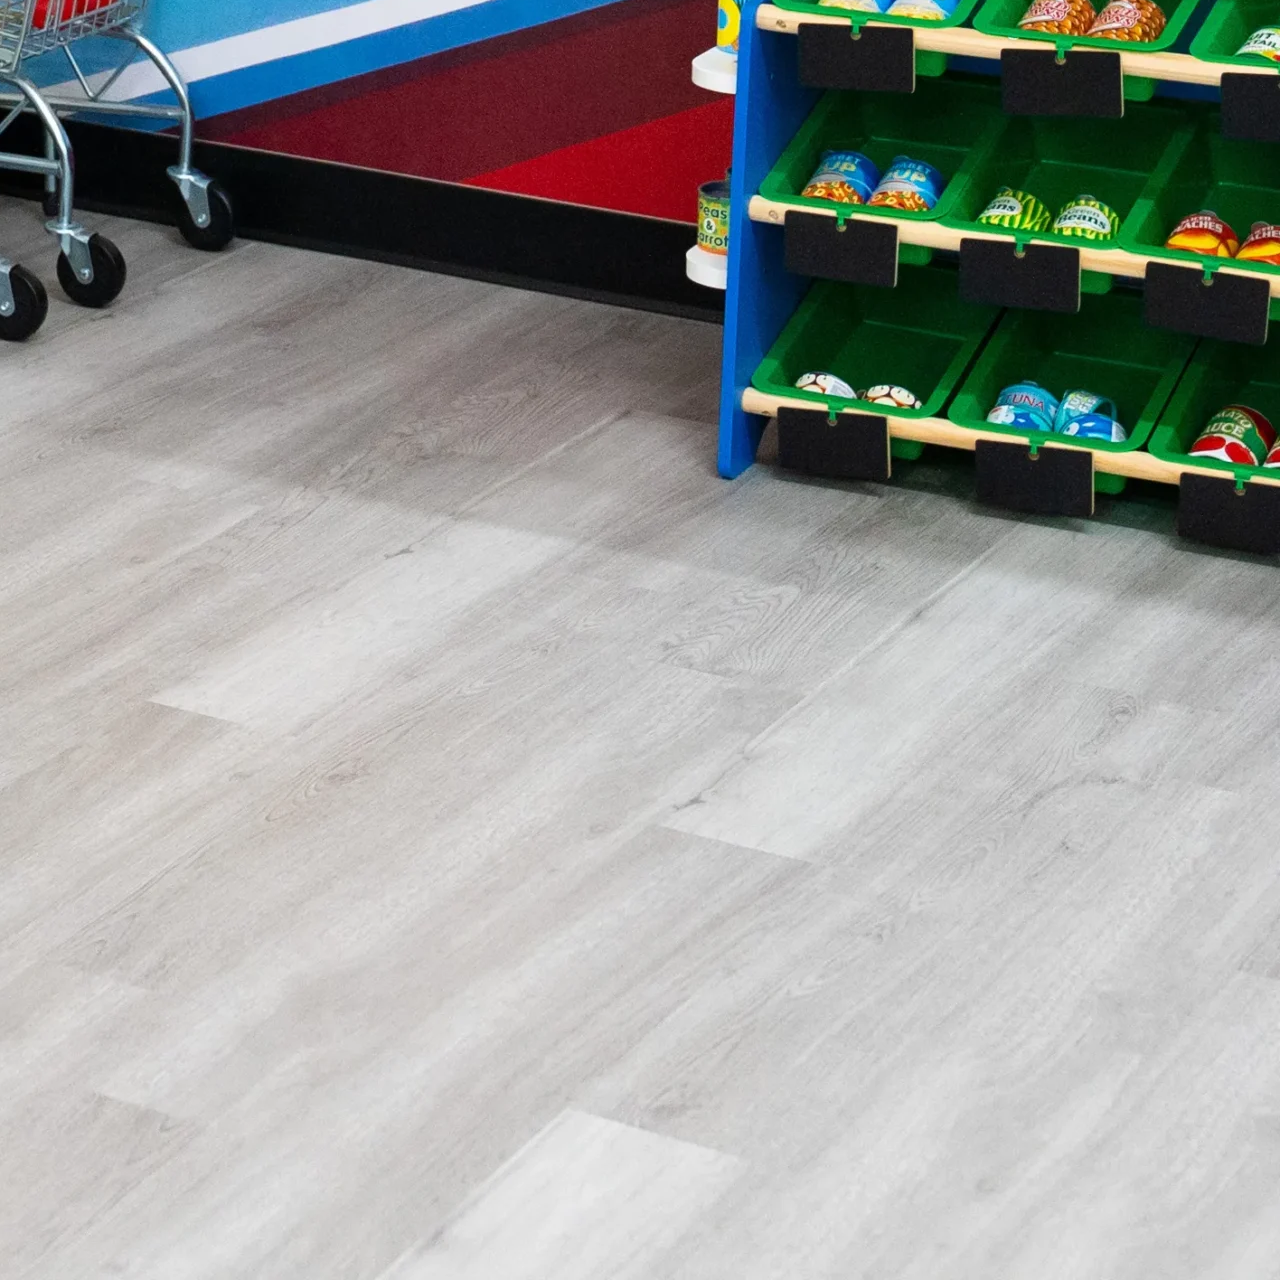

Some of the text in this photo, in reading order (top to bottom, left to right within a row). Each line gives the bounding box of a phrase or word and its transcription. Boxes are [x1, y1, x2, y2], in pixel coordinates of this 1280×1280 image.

[986, 202, 1017, 213] ans
[705, 220, 713, 231] &
[698, 231, 728, 247] arrot
[1005, 392, 1045, 412] TUNA
[1204, 422, 1246, 439] AUCE
